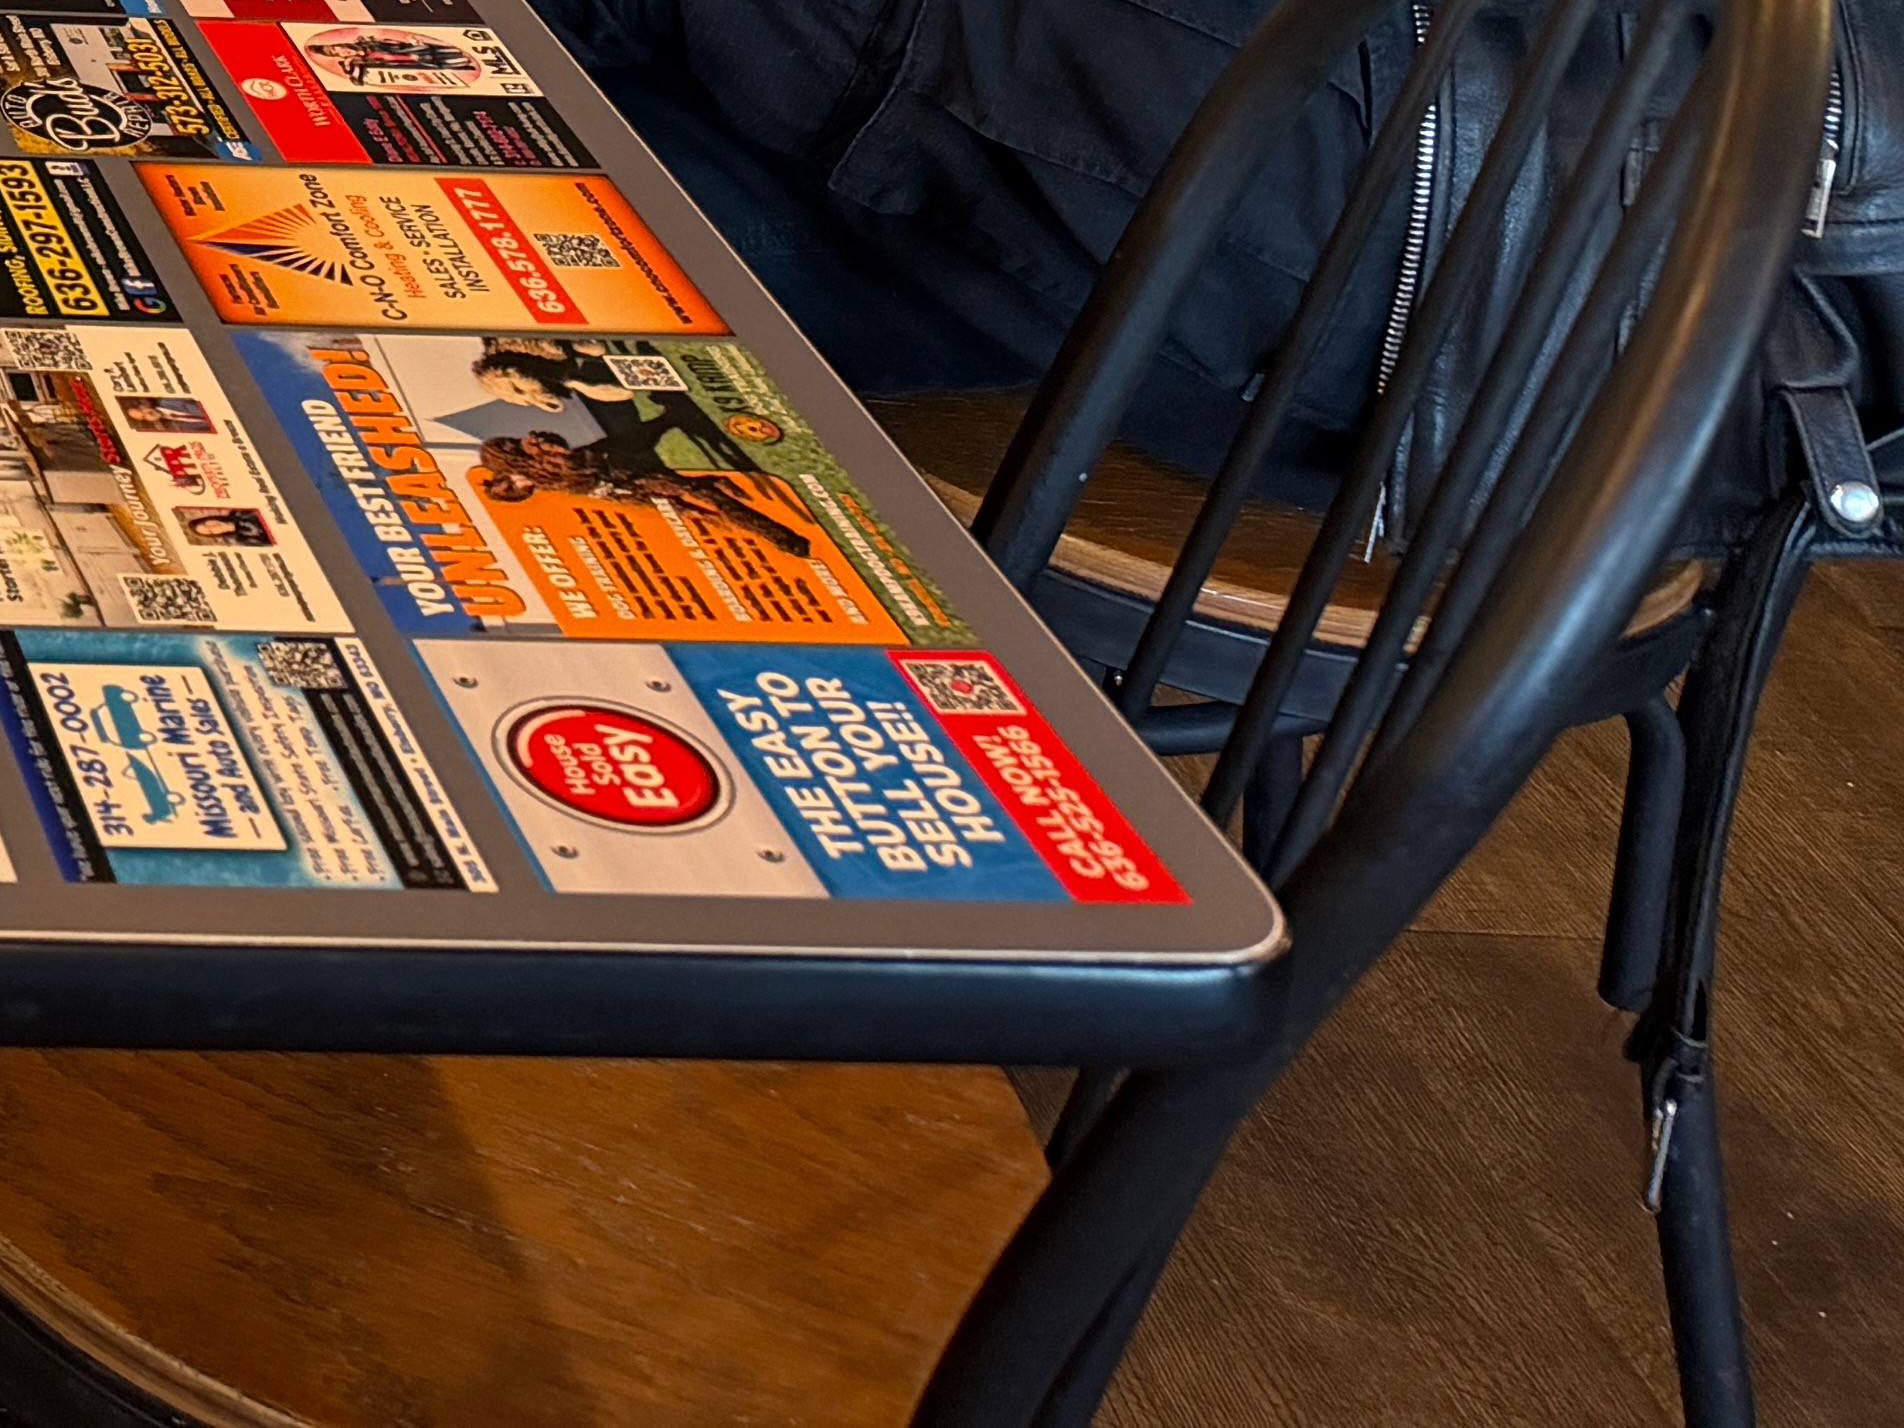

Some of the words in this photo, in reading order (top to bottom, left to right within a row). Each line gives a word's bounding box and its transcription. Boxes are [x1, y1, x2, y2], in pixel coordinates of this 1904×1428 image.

[6, 95, 39, 128] AUTO
[24, 78, 121, 151] Bud's
[128, 38, 210, 135] 573-312-5031
[297, 173, 338, 209] Zone
[379, 196, 433, 248] SERVICE
[324, 212, 379, 271] Comfort
[411, 204, 490, 293] INSTALLATION
[454, 187, 567, 313] 636.578.1777
[5, 256, 49, 315] ROOFING,
[425, 258, 467, 299] SALES
[301, 399, 373, 481] FRIEND
[109, 464, 161, 527] Journey
[308, 347, 528, 617] UNLEASHED!
[356, 486, 416, 542] BEST
[140, 529, 172, 566] Your
[386, 547, 455, 615] YOUR
[524, 527, 582, 588] OFFER:
[556, 591, 596, 619] WE
[140, 675, 191, 743] Marine
[191, 698, 225, 736] Sales
[756, 672, 813, 718] TO
[805, 678, 899, 771] YOUR
[40, 672, 133, 836] 314-287-0002
[206, 741, 243, 779] Auto
[544, 734, 595, 796] House
[572, 743, 621, 786] Sold
[593, 725, 681, 808] Easy
[716, 688, 812, 778] EASY
[167, 752, 239, 838] Missouri
[225, 784, 261, 814] and
[790, 726, 928, 871] BUTTON
[866, 701, 1006, 843] HOUSE!!
[973, 735, 1050, 806] NOW!
[784, 786, 864, 859] THE
[883, 779, 972, 867] SELL
[998, 726, 1149, 889] 636-525-1566
[1044, 810, 1106, 879] CALL
